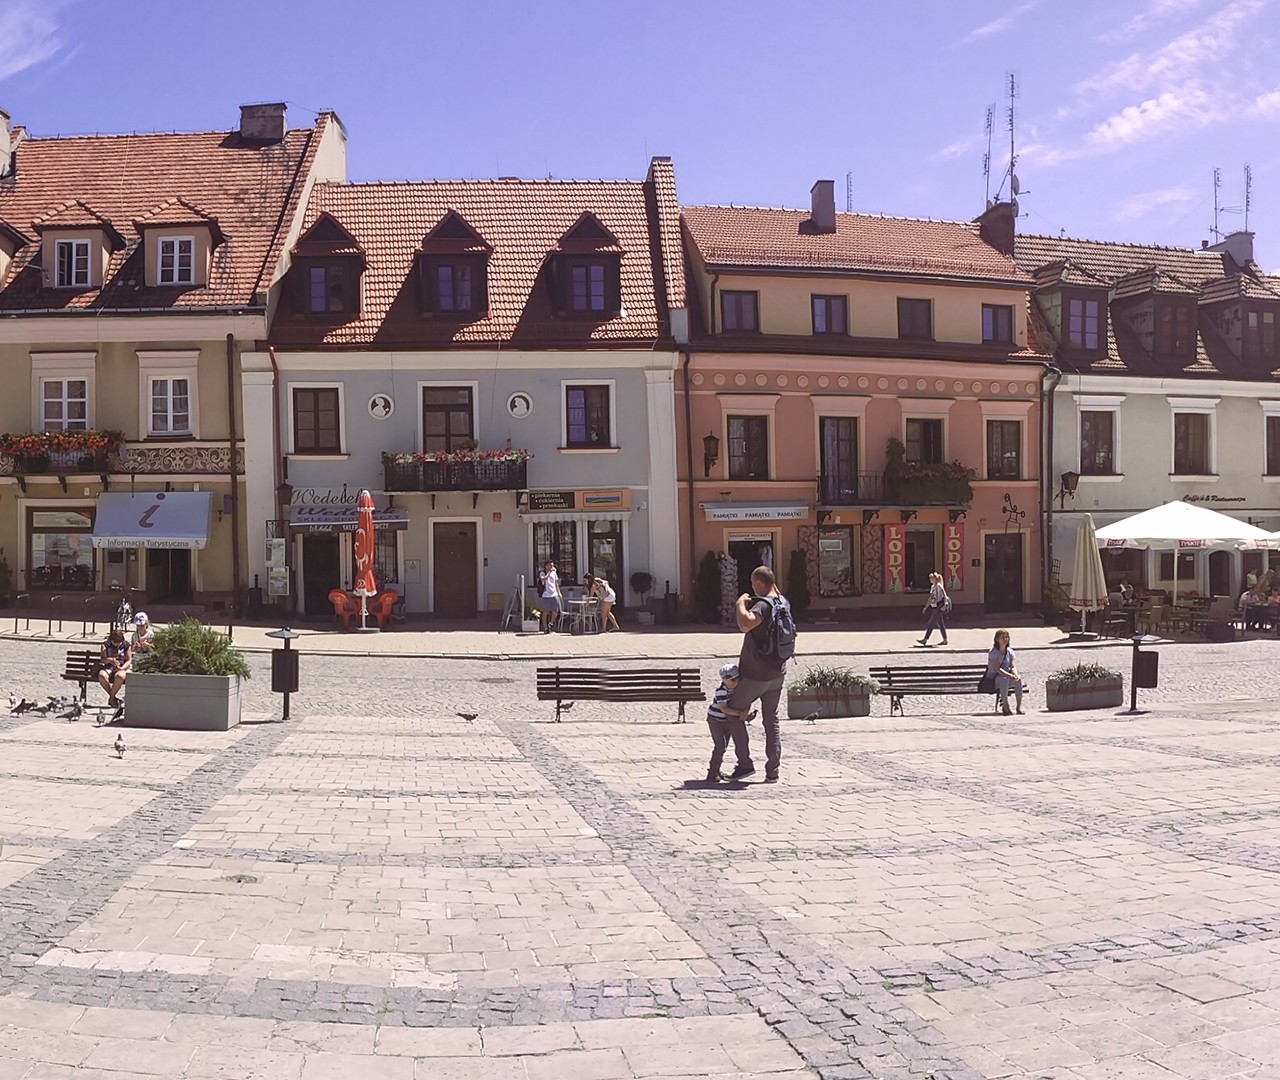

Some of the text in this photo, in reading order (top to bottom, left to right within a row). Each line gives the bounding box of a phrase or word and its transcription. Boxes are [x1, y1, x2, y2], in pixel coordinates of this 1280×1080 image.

[147, 540, 189, 548] Turystyczna
[888, 527, 903, 578] LODY
[948, 526, 961, 577] LODY
